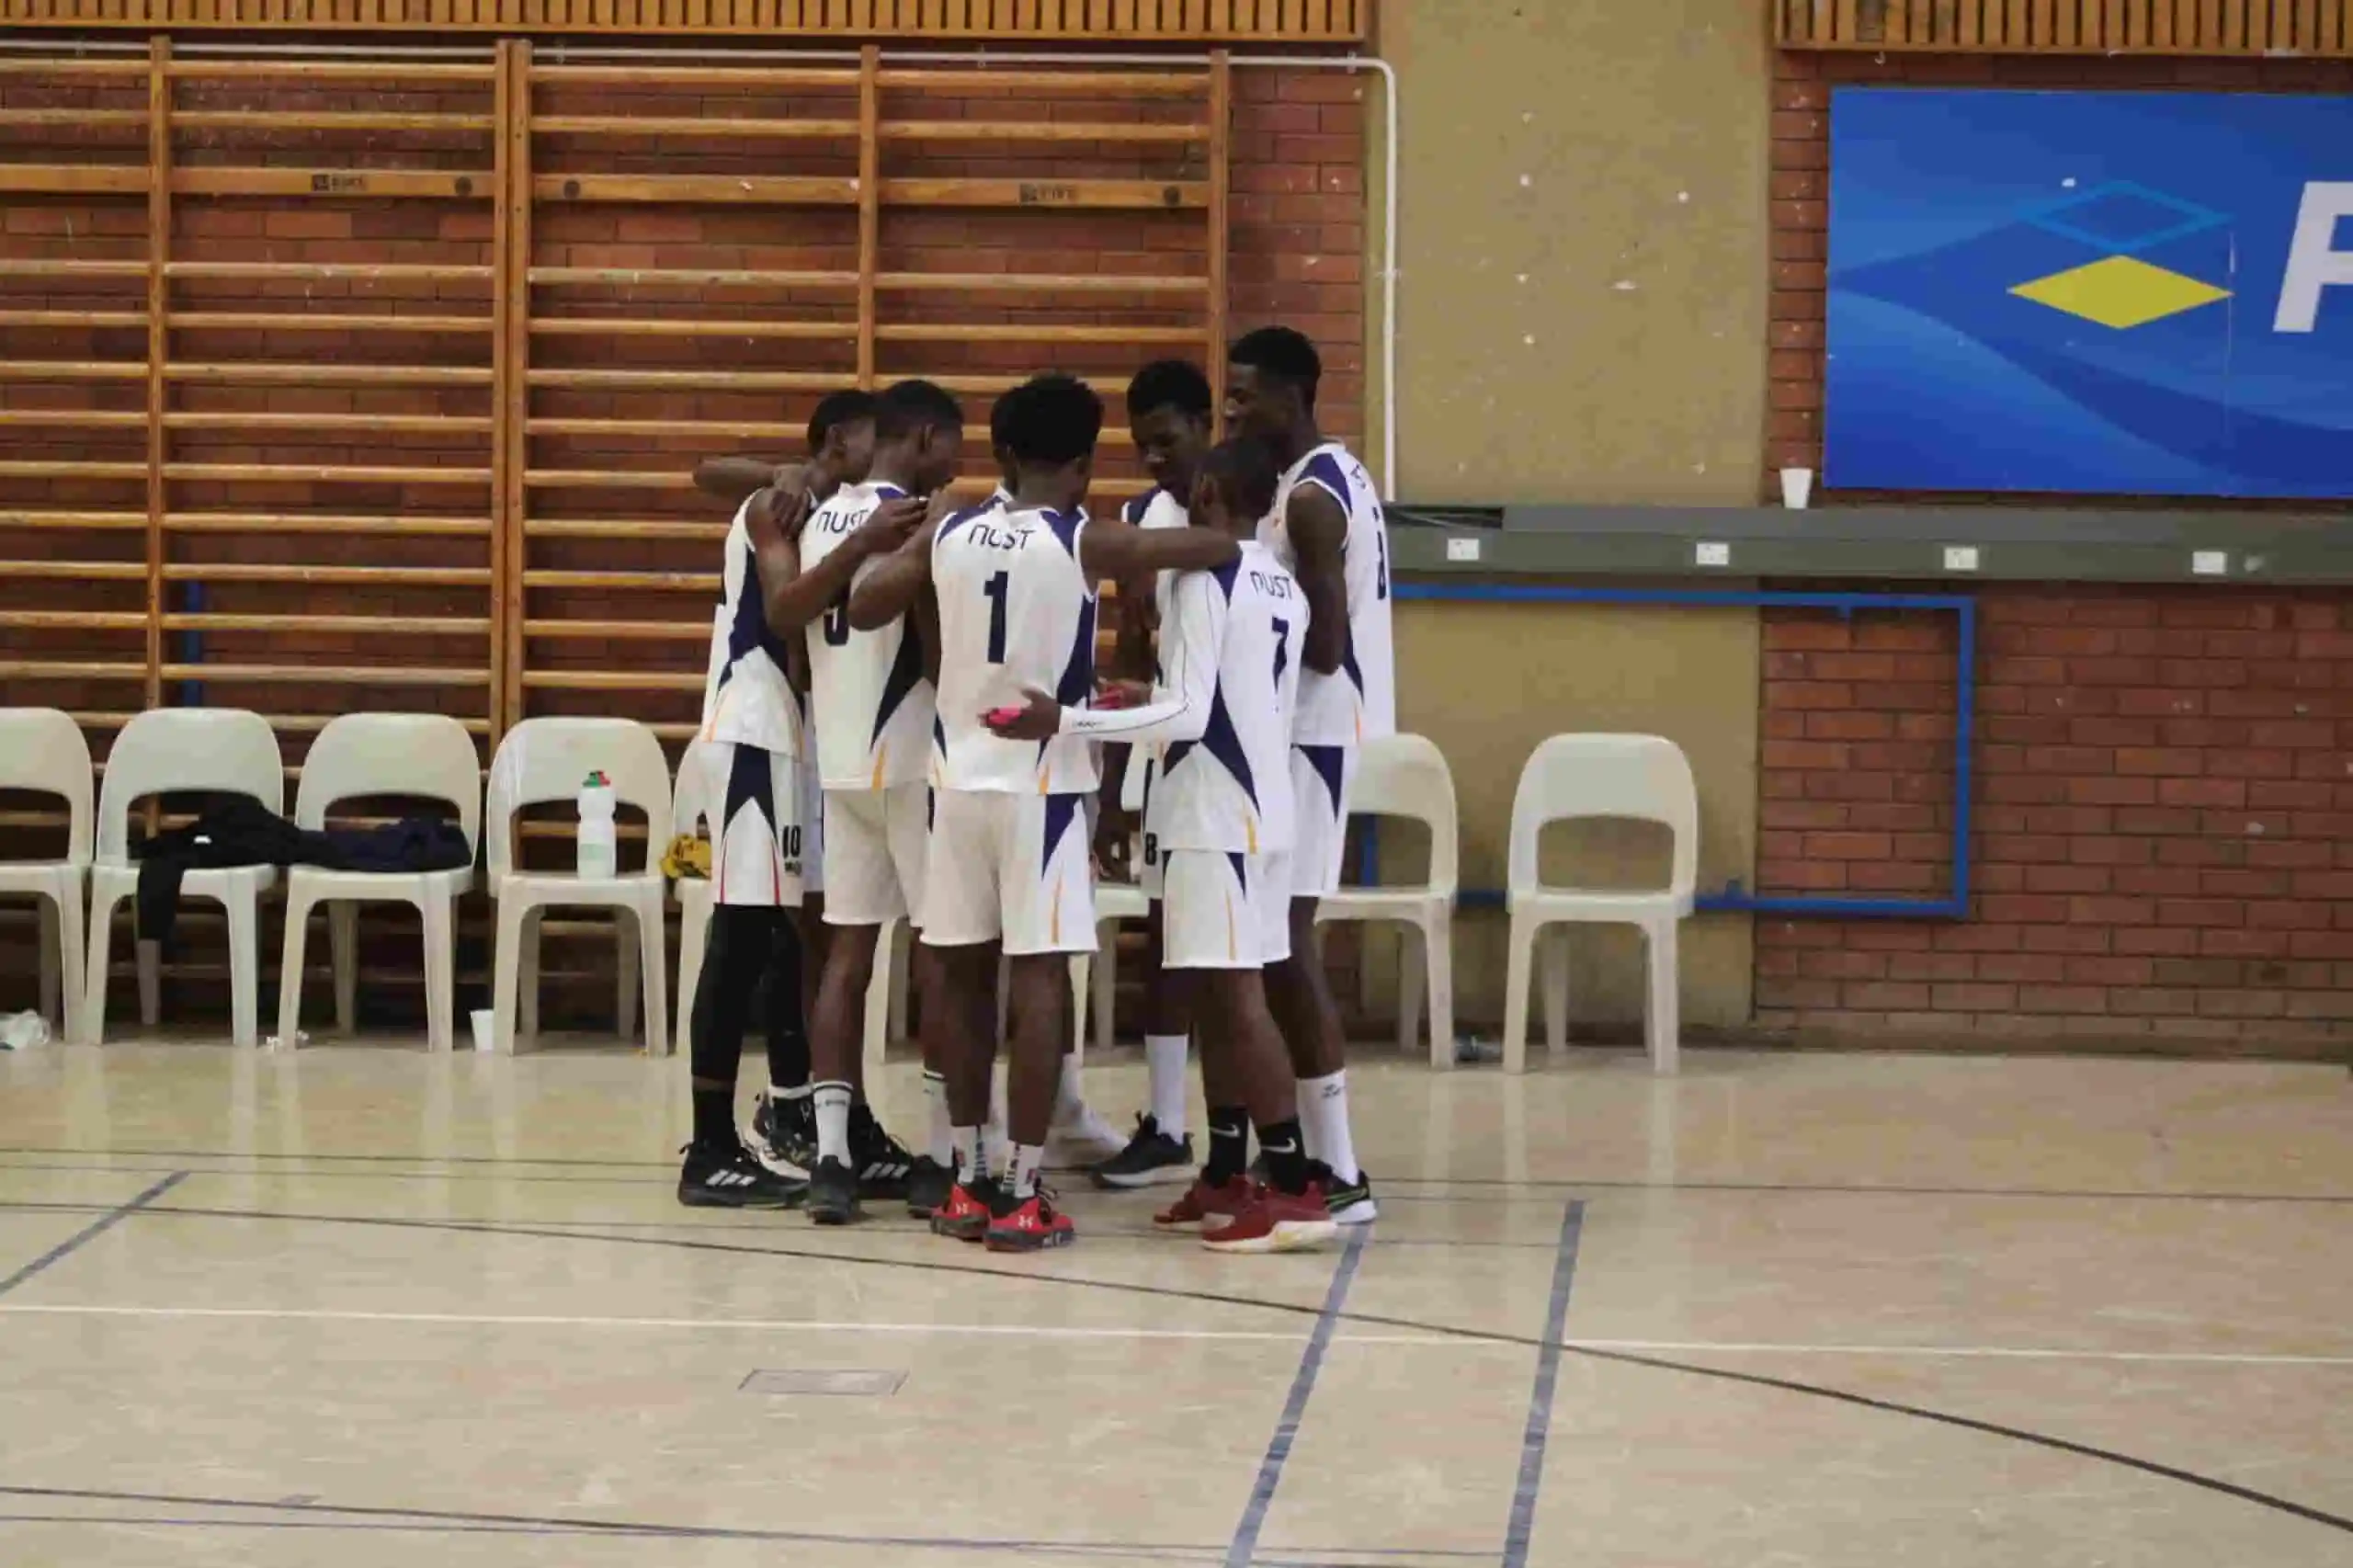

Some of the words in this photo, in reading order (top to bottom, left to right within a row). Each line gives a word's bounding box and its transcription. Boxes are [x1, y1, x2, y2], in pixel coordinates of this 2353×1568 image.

[984, 571, 1008, 664] 1
[1272, 616, 1290, 695] 7
[782, 825, 801, 858] 10
